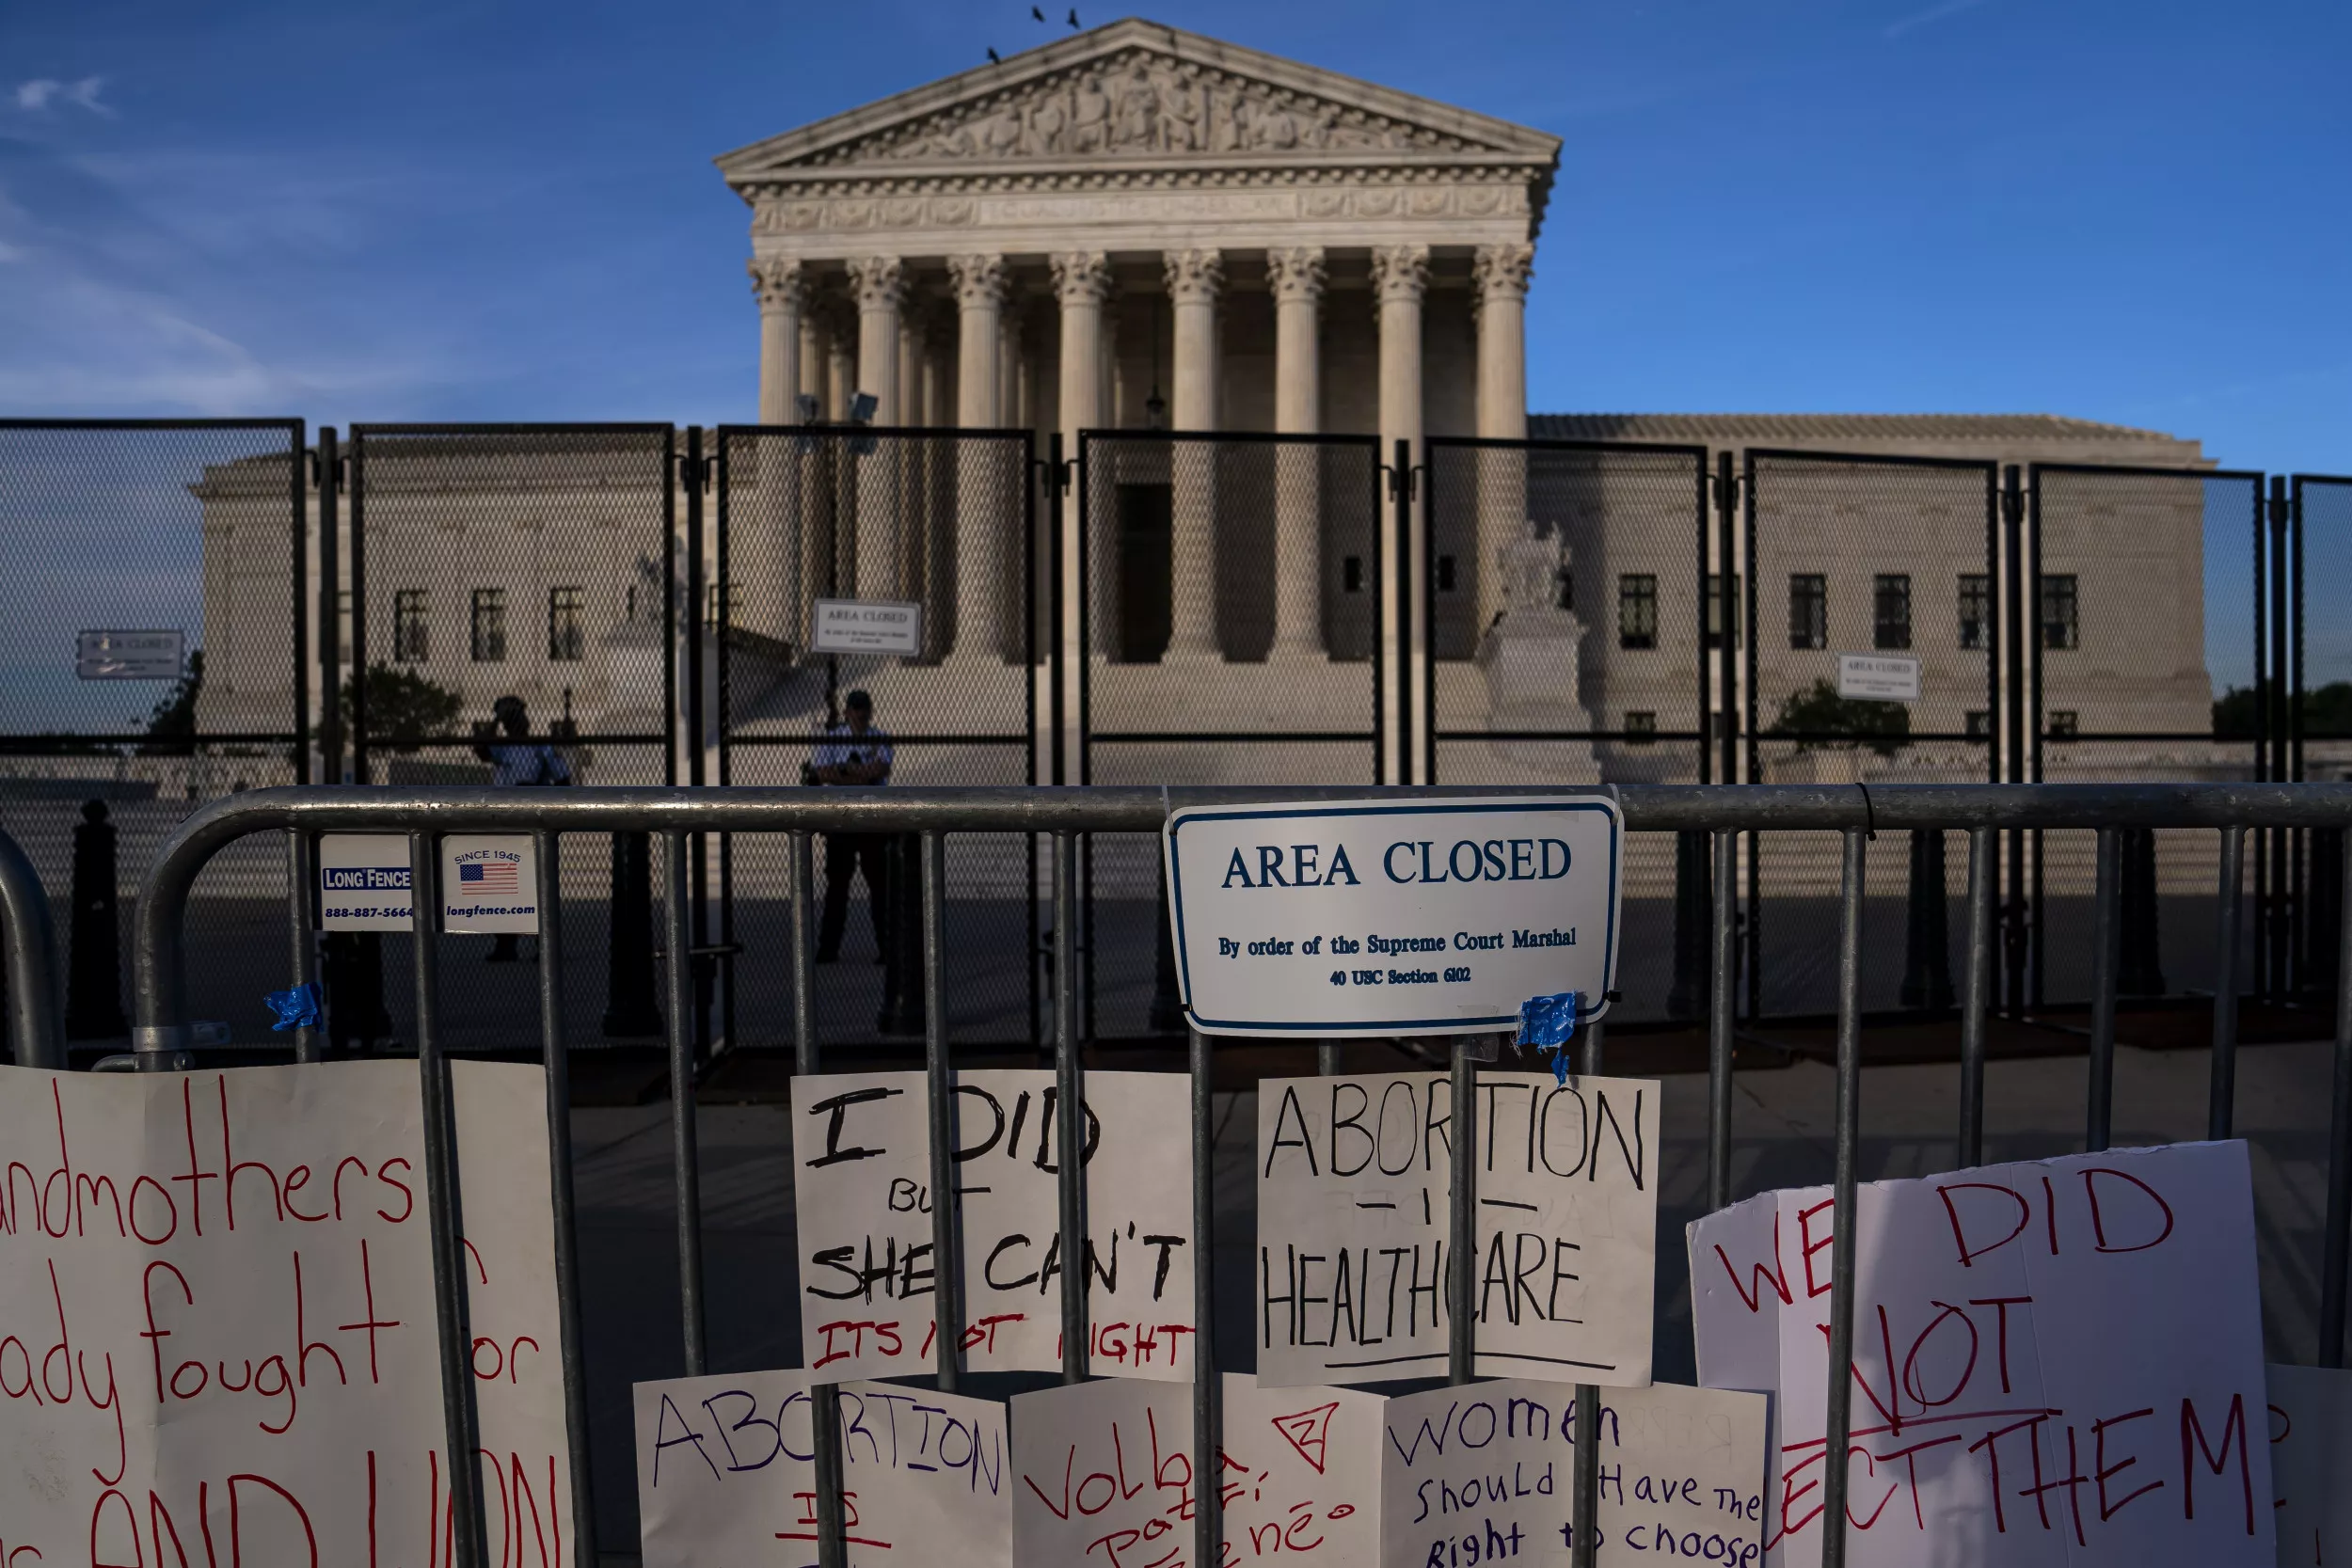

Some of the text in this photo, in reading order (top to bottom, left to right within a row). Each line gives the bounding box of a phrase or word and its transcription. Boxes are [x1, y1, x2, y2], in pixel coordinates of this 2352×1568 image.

[326, 868, 411, 888] LONG FENCE
[454, 850, 521, 864] SINCE 1945
[1221, 838, 1572, 888] AREA CLOSED
[325, 907, 414, 918] 888-887-5664
[446, 904, 536, 918] longfence.com
[1219, 927, 1577, 958] By order of the Supreme Court Marshal
[1329, 966, 1471, 987] 40 USC Section 6102
[805, 1086, 904, 1167] I
[1264, 1080, 1644, 1191] ABORTION
[1714, 1167, 2174, 1313] WE DID
[805, 1234, 936, 1306] SHE
[139, 1239, 401, 1433] fought
[812, 1320, 904, 1370] ITS
[1057, 1322, 1197, 1369] IGHT
[654, 1390, 1000, 1496] ABORTION
[1967, 1392, 2255, 1546] THEM
